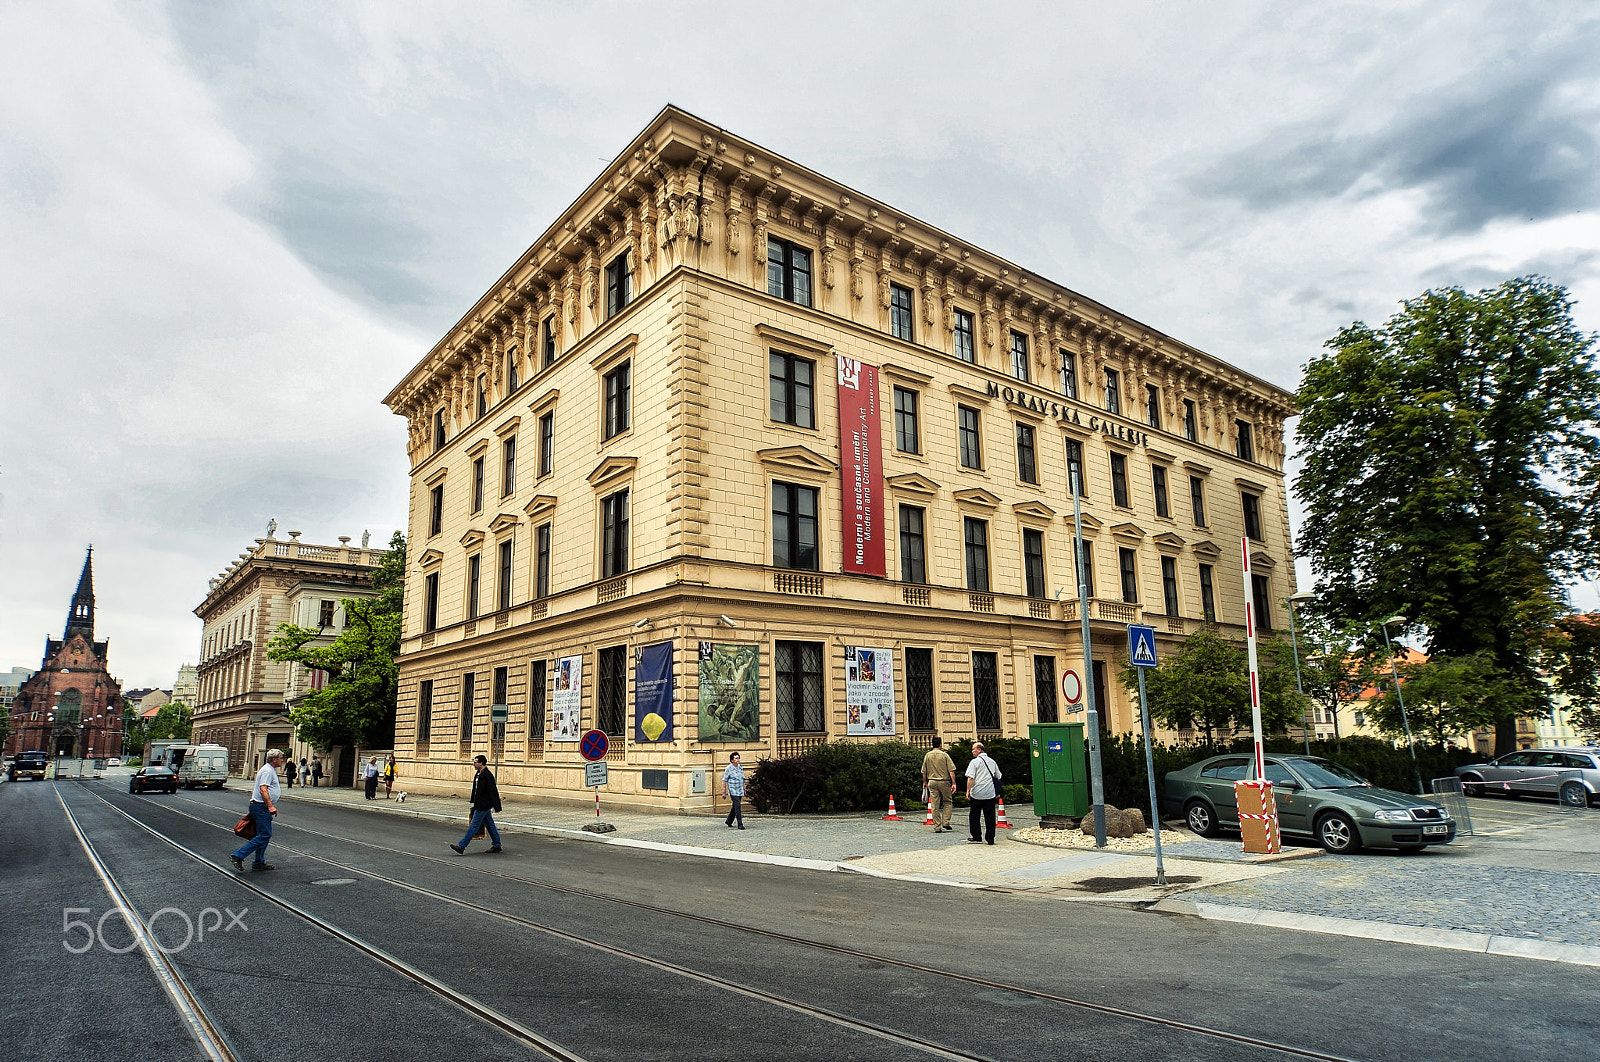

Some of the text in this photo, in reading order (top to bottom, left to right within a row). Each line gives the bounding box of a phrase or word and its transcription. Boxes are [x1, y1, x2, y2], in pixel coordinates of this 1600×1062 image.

[851, 430, 861, 461] umění
[1089, 416, 1149, 447] GALERIE
[861, 423, 870, 485] Contemporary
[854, 464, 863, 511] současné
[863, 487, 871, 504] and
[855, 522, 864, 565] Moderní
[847, 696, 860, 704] Like
[861, 696, 868, 704] in
[874, 696, 892, 704] Mirror
